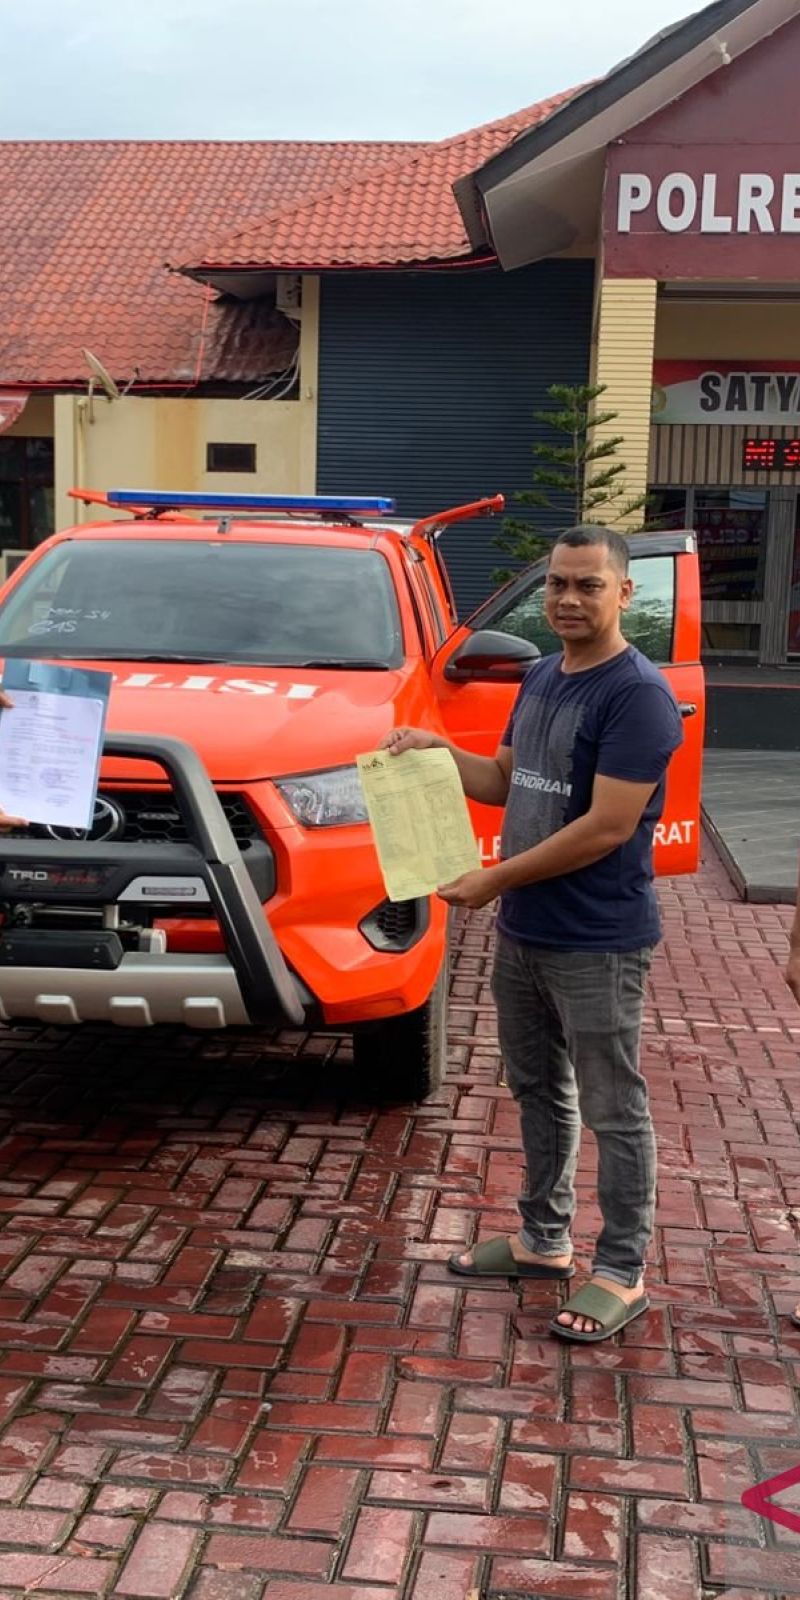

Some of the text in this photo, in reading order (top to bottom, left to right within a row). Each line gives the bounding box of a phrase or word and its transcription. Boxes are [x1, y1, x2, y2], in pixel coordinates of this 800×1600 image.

[700, 374, 800, 413] SATY
[112, 673, 321, 699] LISI
[8, 870, 48, 881] TRD
